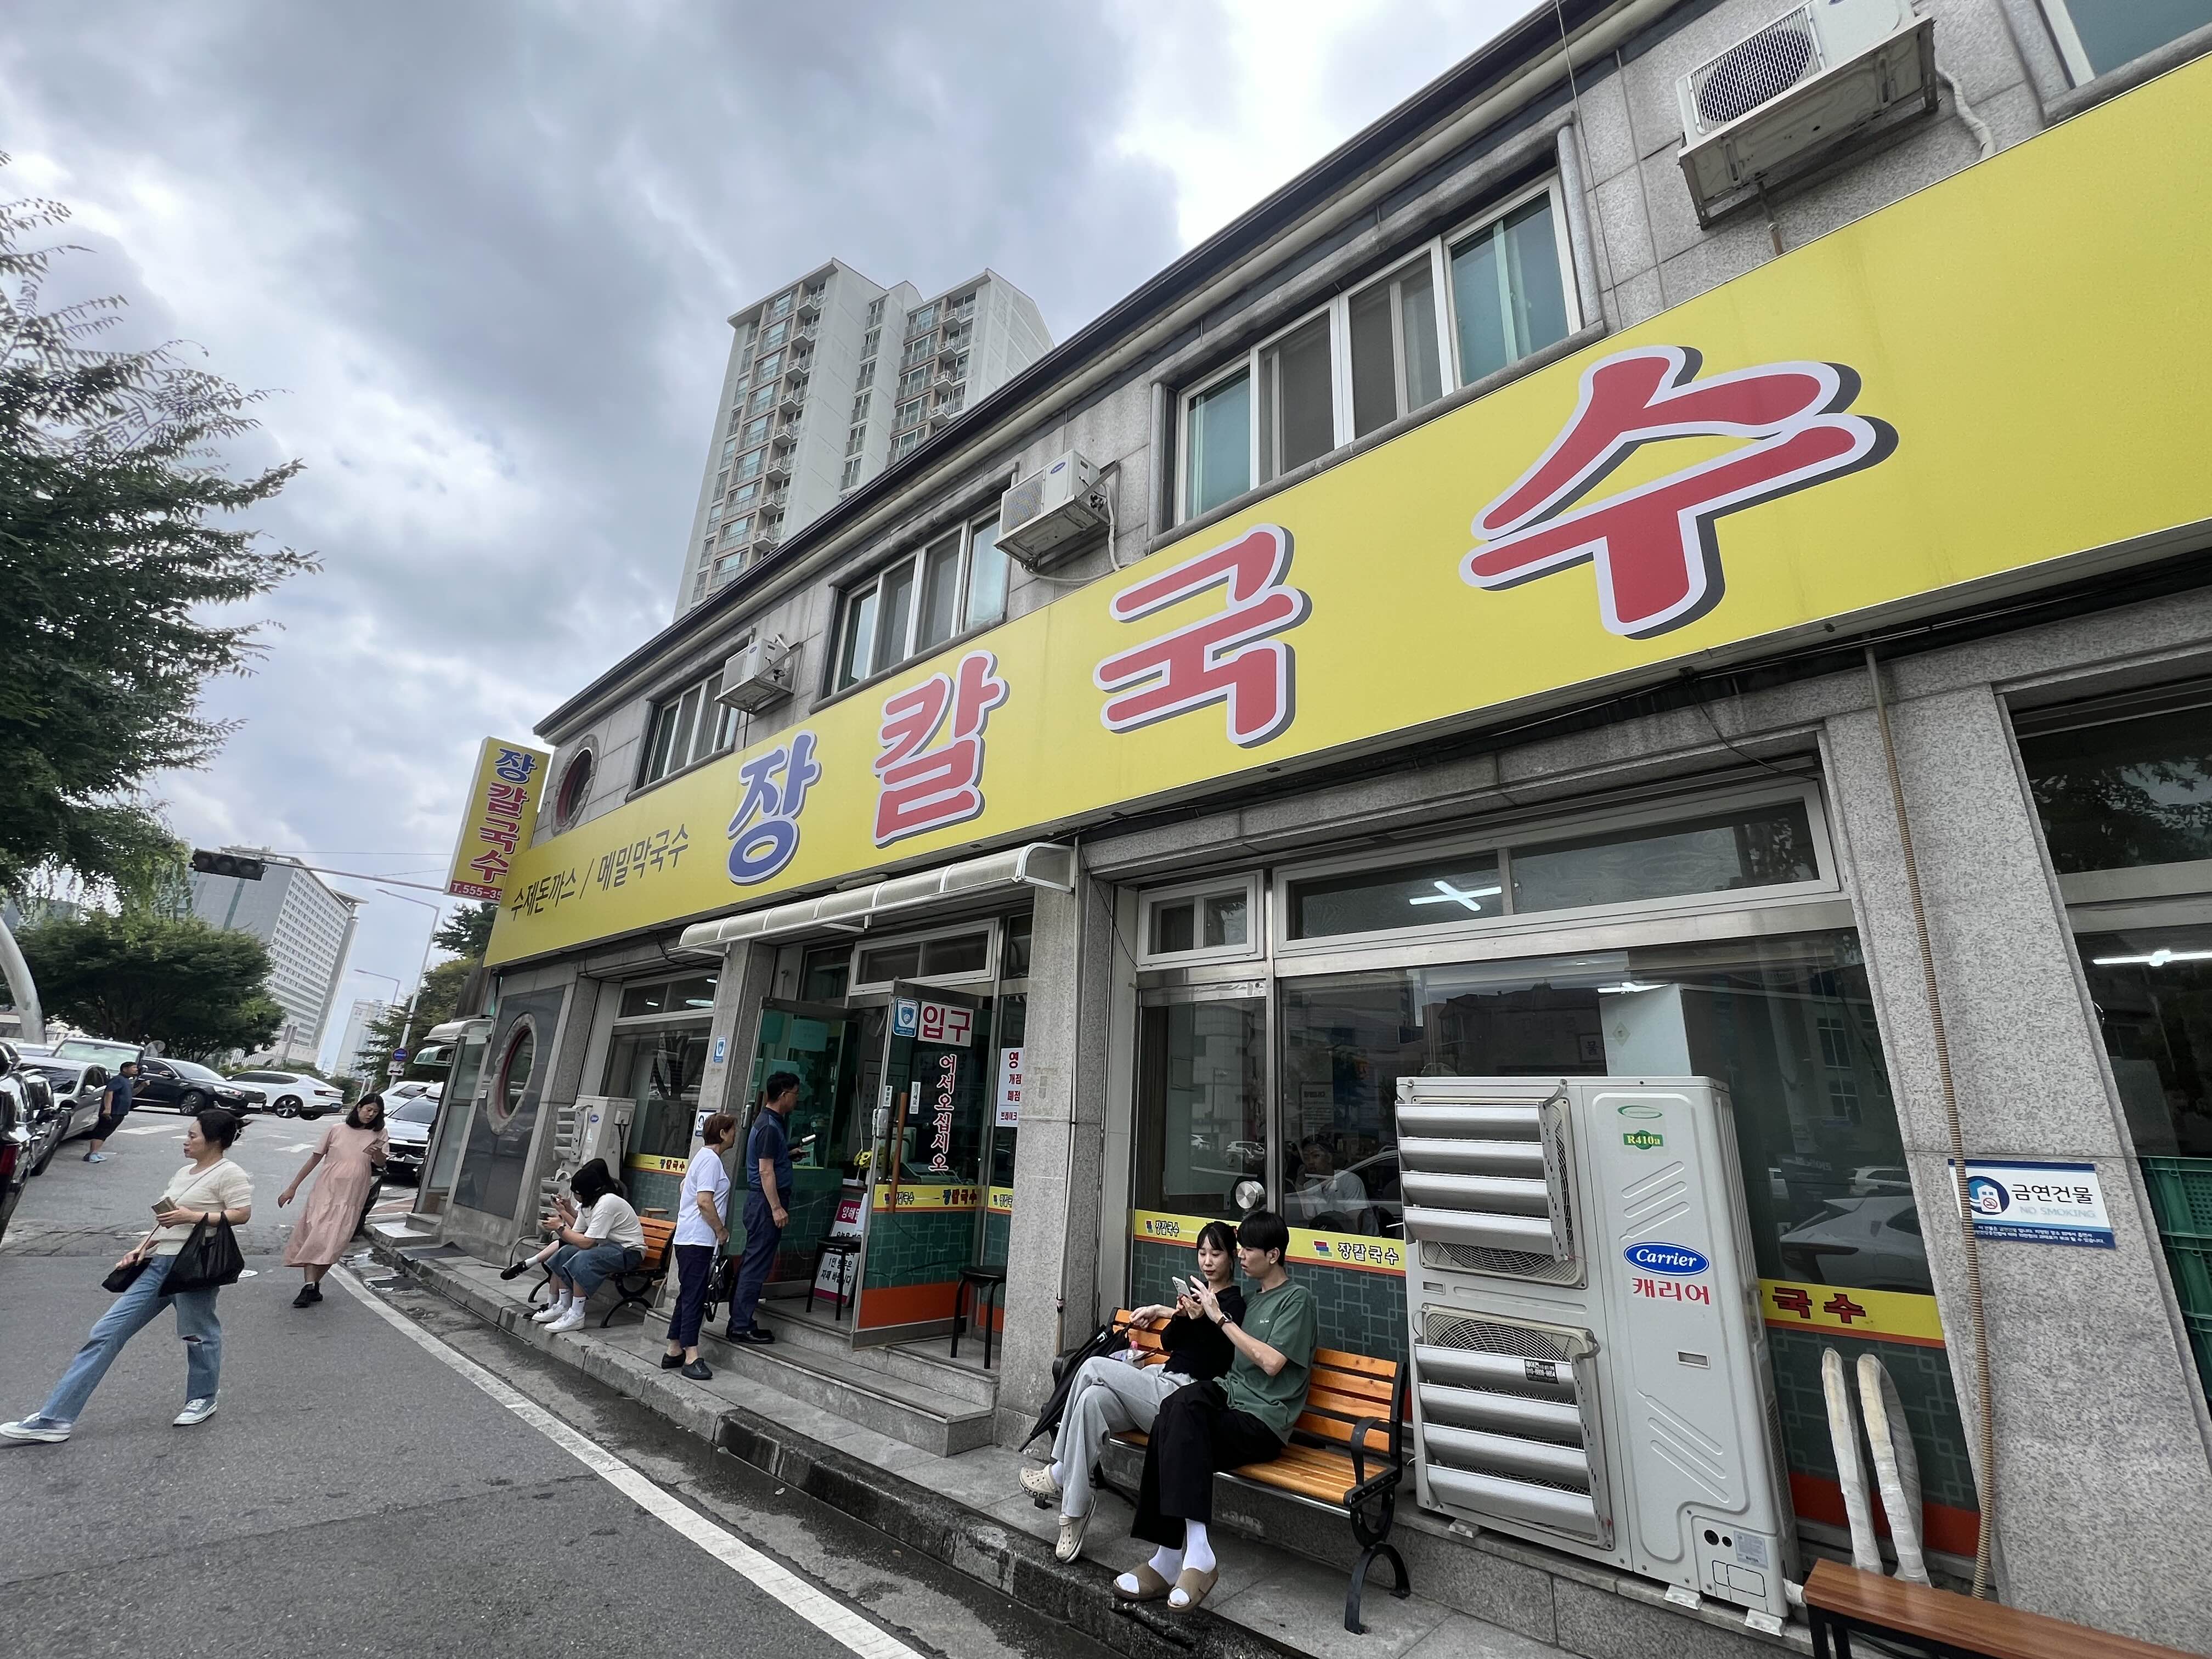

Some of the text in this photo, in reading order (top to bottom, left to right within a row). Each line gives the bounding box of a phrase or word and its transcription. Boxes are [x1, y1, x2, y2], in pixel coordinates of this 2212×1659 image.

[727, 345, 1899, 887] 장칼국수
[470, 747, 537, 884] 장칼국수
[511, 868, 576, 921] 수제돈까스
[597, 823, 688, 891] 메밀막국수
[923, 1006, 970, 1042] 입구
[928, 1054, 957, 1171] 어서오십시오
[1001, 1111, 1018, 1121] 브레이크
[1627, 1135, 1661, 1145] R410a
[895, 1191, 915, 1205] 칼국수
[2011, 1183, 2093, 1205] 금연건물
[2020, 1206, 2095, 1218] NO SMOKING
[1155, 1220, 1180, 1237] 장칼국수
[1338, 1242, 1400, 1265] 장칼국수
[1636, 1249, 1697, 1267] Carrier
[1632, 1277, 1709, 1305] 캐리어
